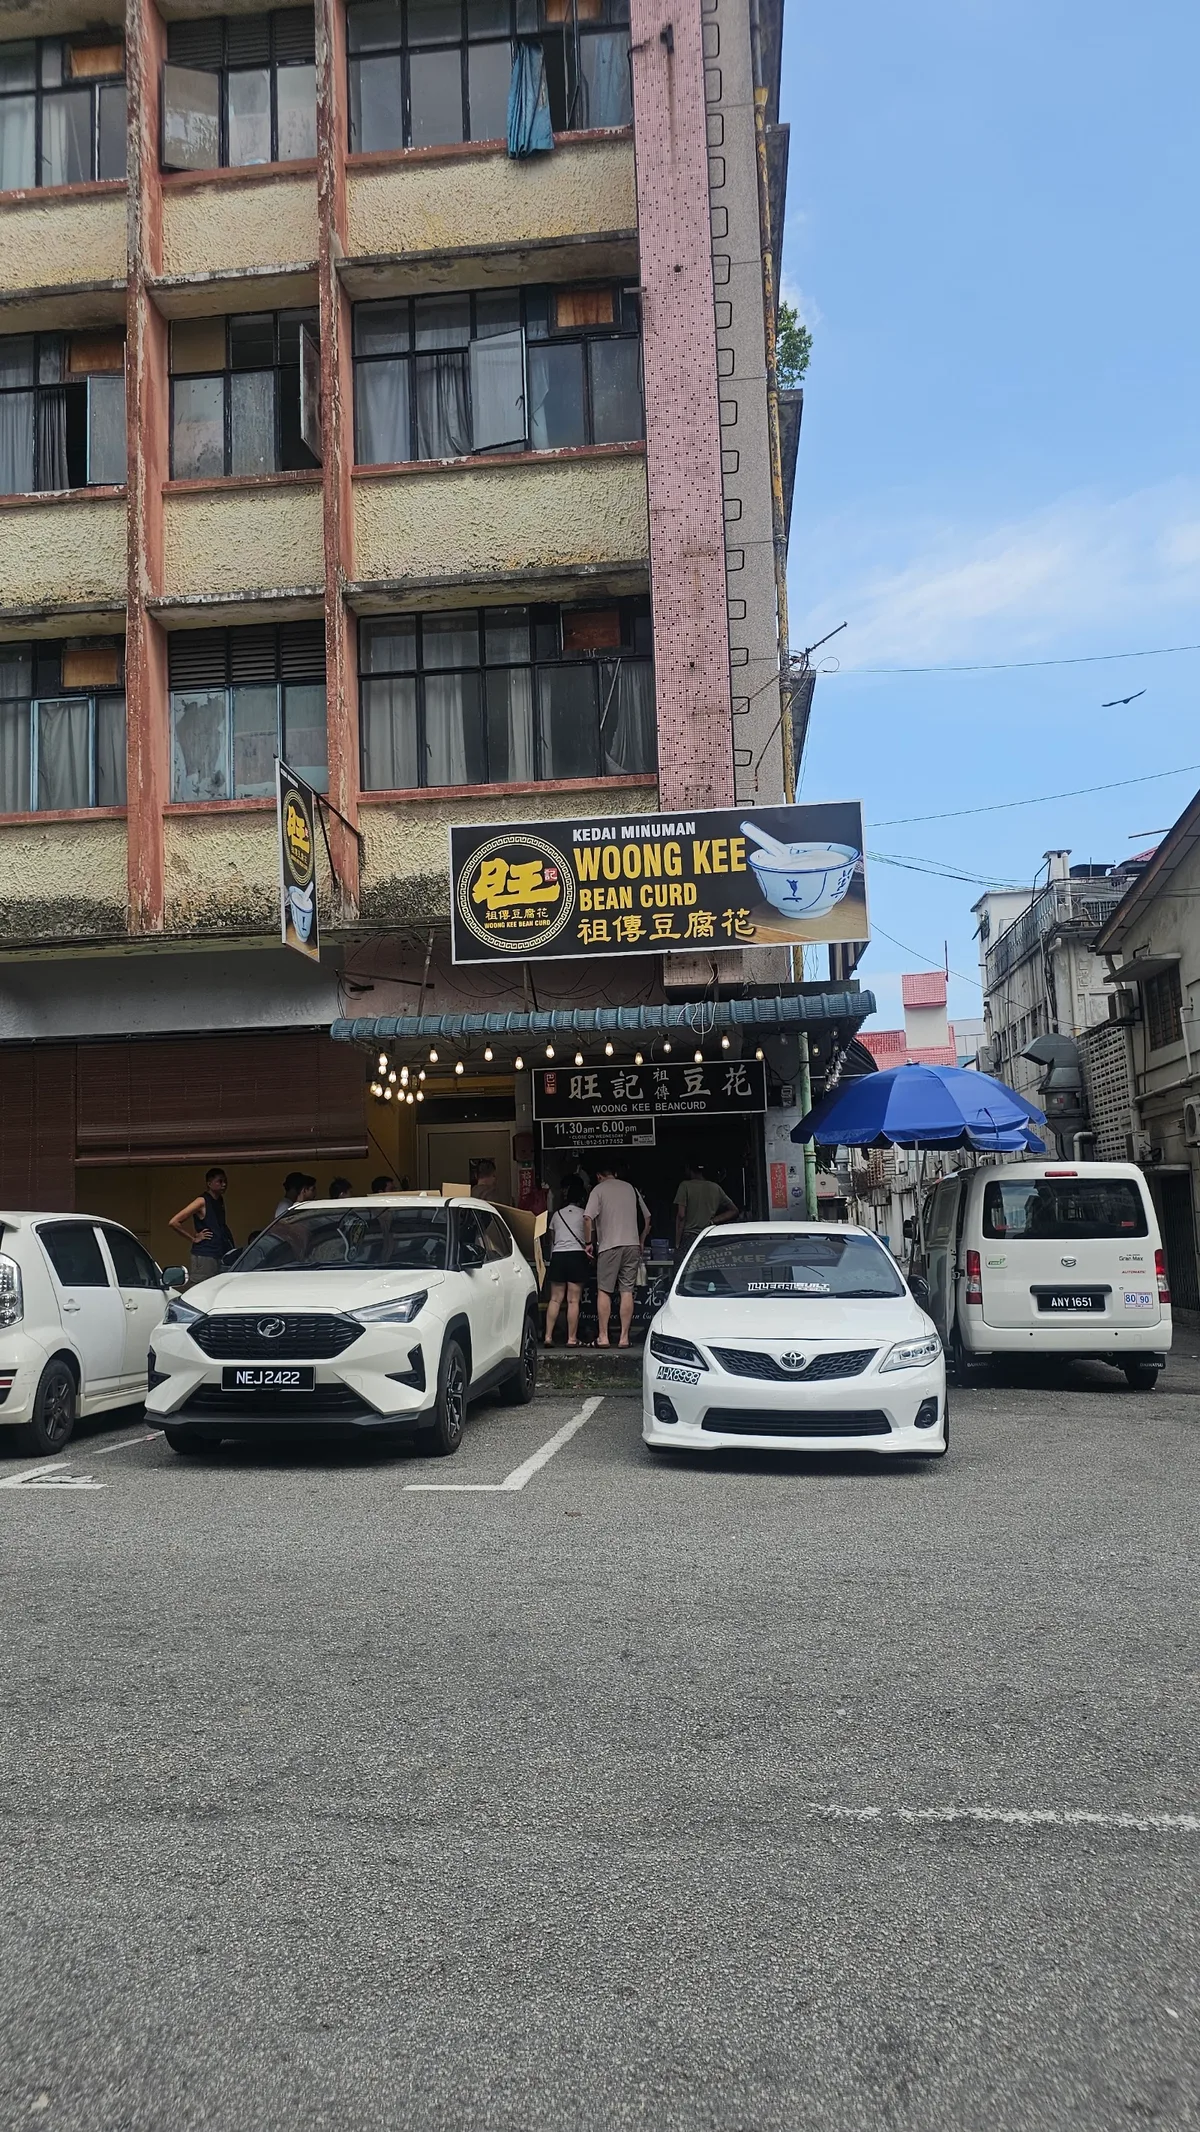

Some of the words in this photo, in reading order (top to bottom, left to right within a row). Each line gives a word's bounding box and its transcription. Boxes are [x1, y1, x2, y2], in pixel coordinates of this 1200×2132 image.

[572, 827, 616, 842] KEDAI
[621, 821, 696, 839] MINUMAN
[573, 841, 683, 882] WOONG
[692, 837, 747, 875] KEE
[472, 857, 561, 911] 旺
[579, 885, 633, 912] BEAN
[639, 882, 698, 908] CURD
[485, 907, 549, 921] 祖傳豆腐花
[484, 921, 506, 929] WOONG
[518, 920, 534, 928] BEAN
[534, 919, 551, 927] CURD
[576, 907, 755, 946] 祖傳豆腐花
[592, 1104, 628, 1114] WOONG
[632, 1102, 651, 1112] KEE
[655, 1100, 707, 1111] BEANCURD
[1051, 1297, 1070, 1307] ANY
[1071, 1297, 1092, 1307] 1651
[1125, 1294, 1136, 1303] 80
[1139, 1295, 1150, 1304] 90
[236, 1370, 300, 1385] NEJ2422
[657, 1366, 700, 1384] AHX8998
